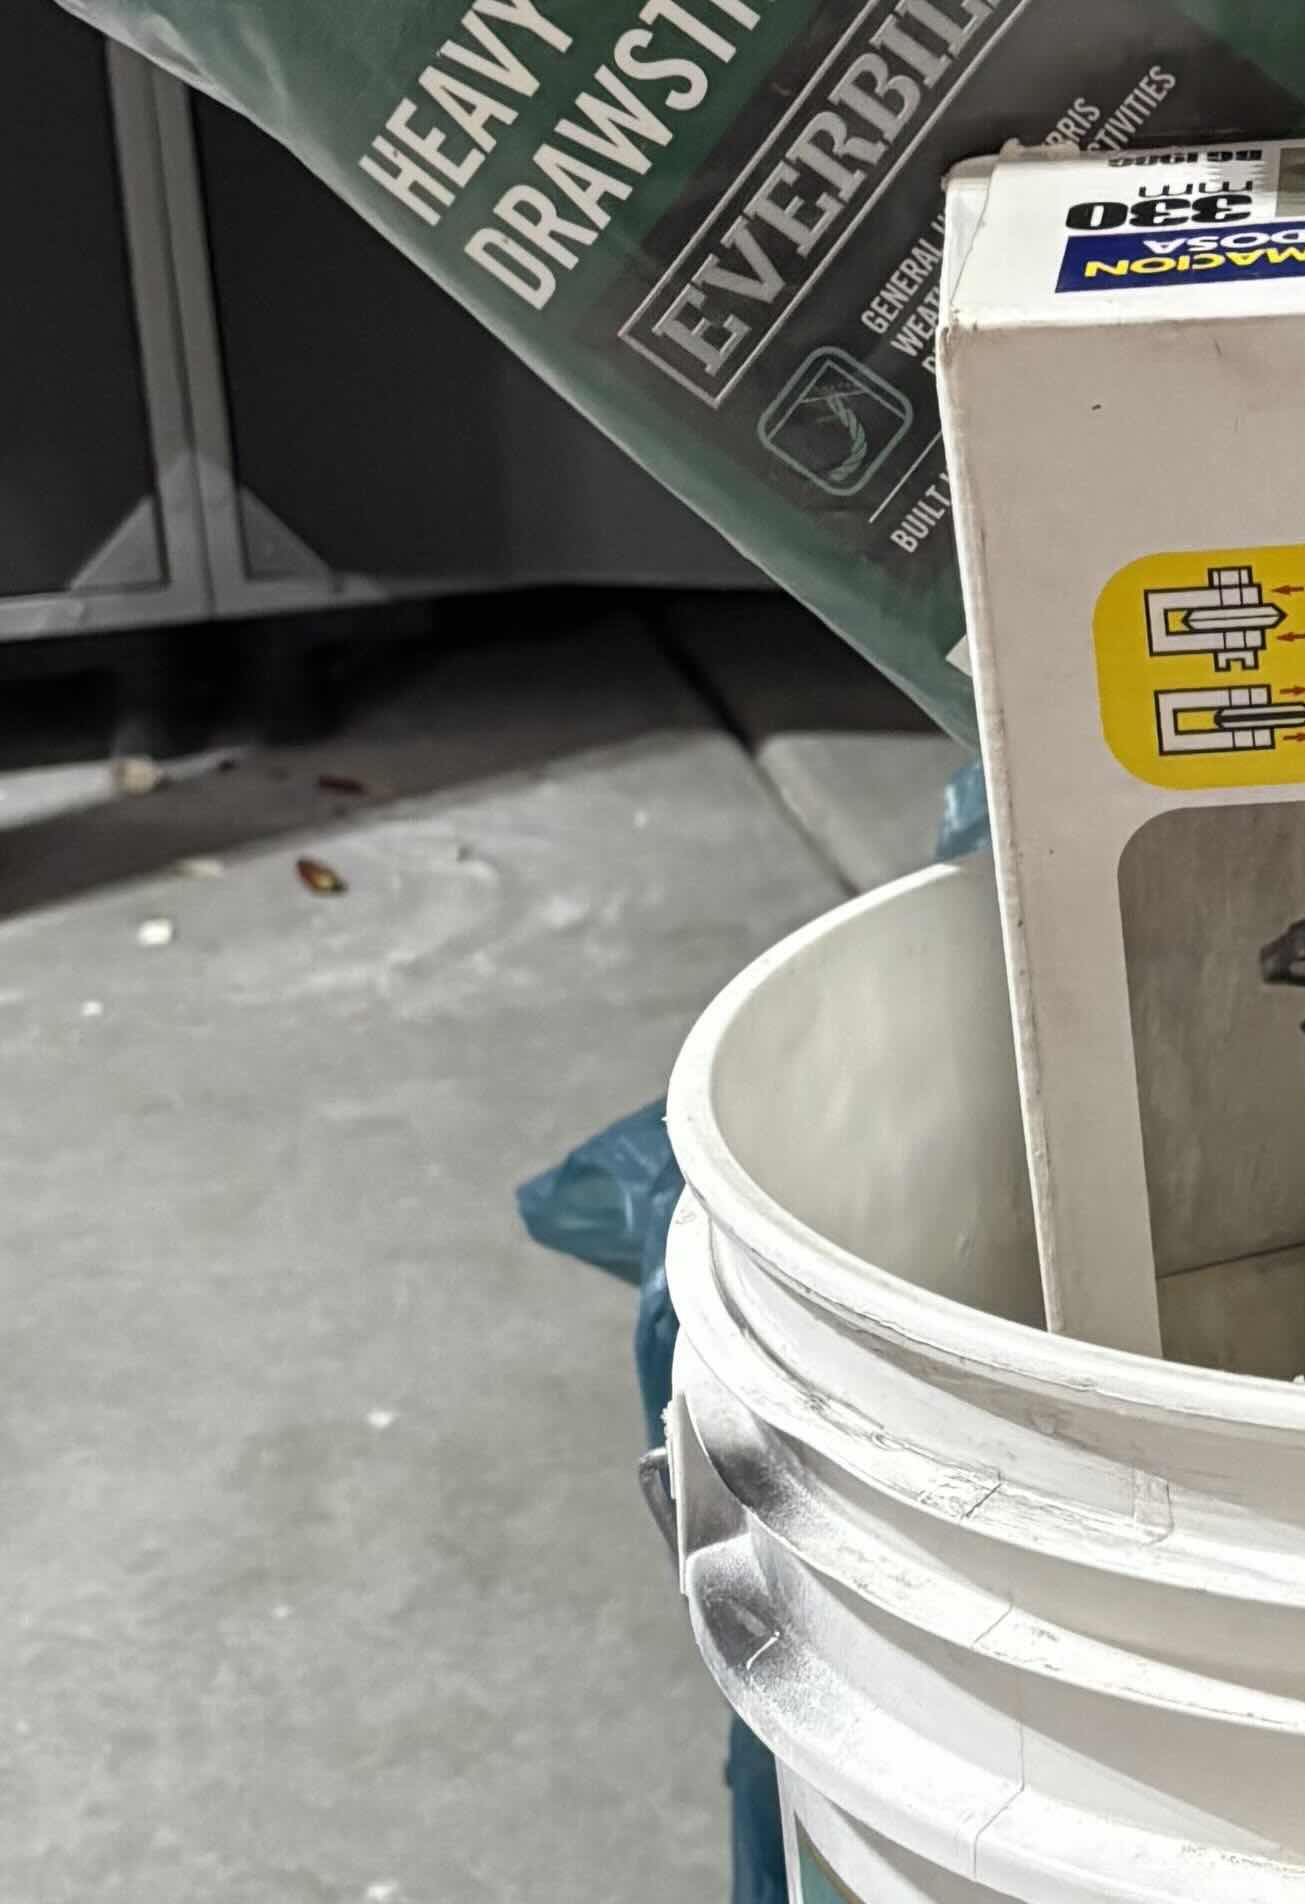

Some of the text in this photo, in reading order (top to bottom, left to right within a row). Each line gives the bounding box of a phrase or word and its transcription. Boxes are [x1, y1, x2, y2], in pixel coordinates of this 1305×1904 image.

[1066, 195, 1252, 230] 330
[1139, 181, 1253, 198] mm
[861, 238, 944, 334] GENERAL
[890, 484, 950, 552] BUILT
